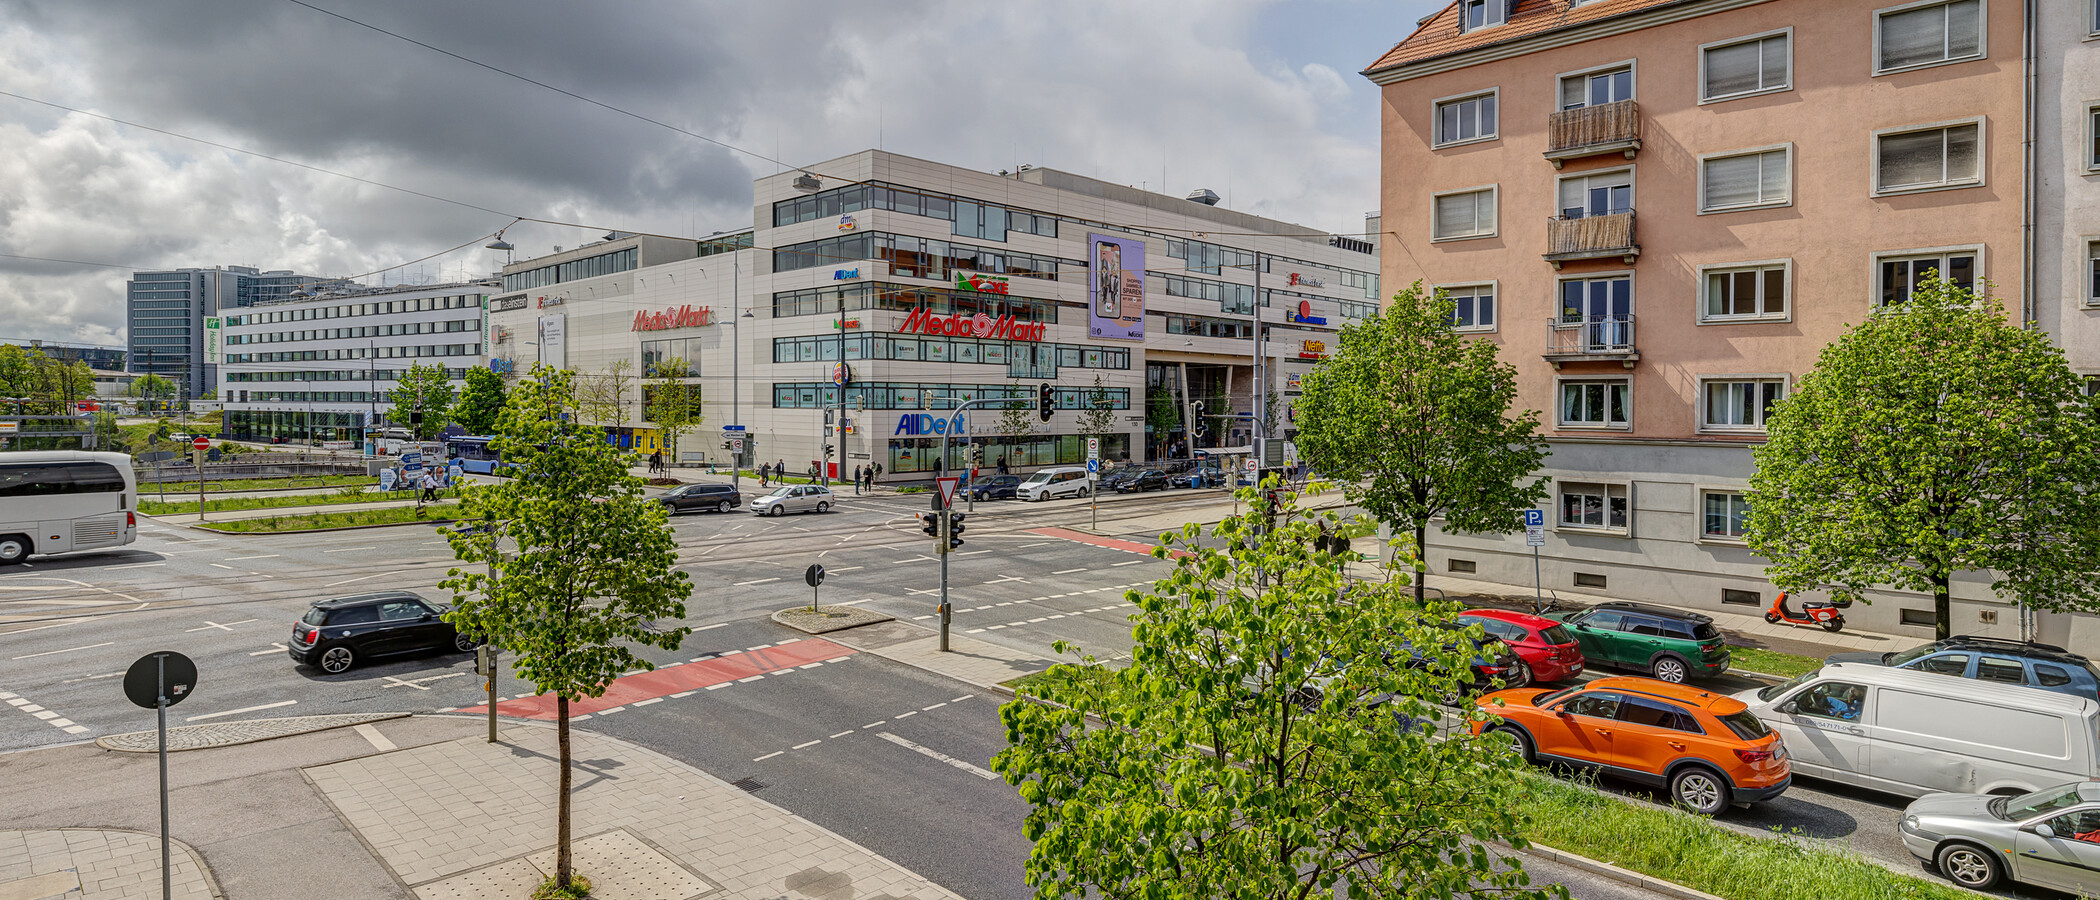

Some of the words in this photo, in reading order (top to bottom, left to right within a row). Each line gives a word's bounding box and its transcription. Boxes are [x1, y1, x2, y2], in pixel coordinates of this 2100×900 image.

[1304, 340, 1326, 352] Netto
[895, 414, 964, 435] AllDent
[1529, 512, 1539, 524] P
